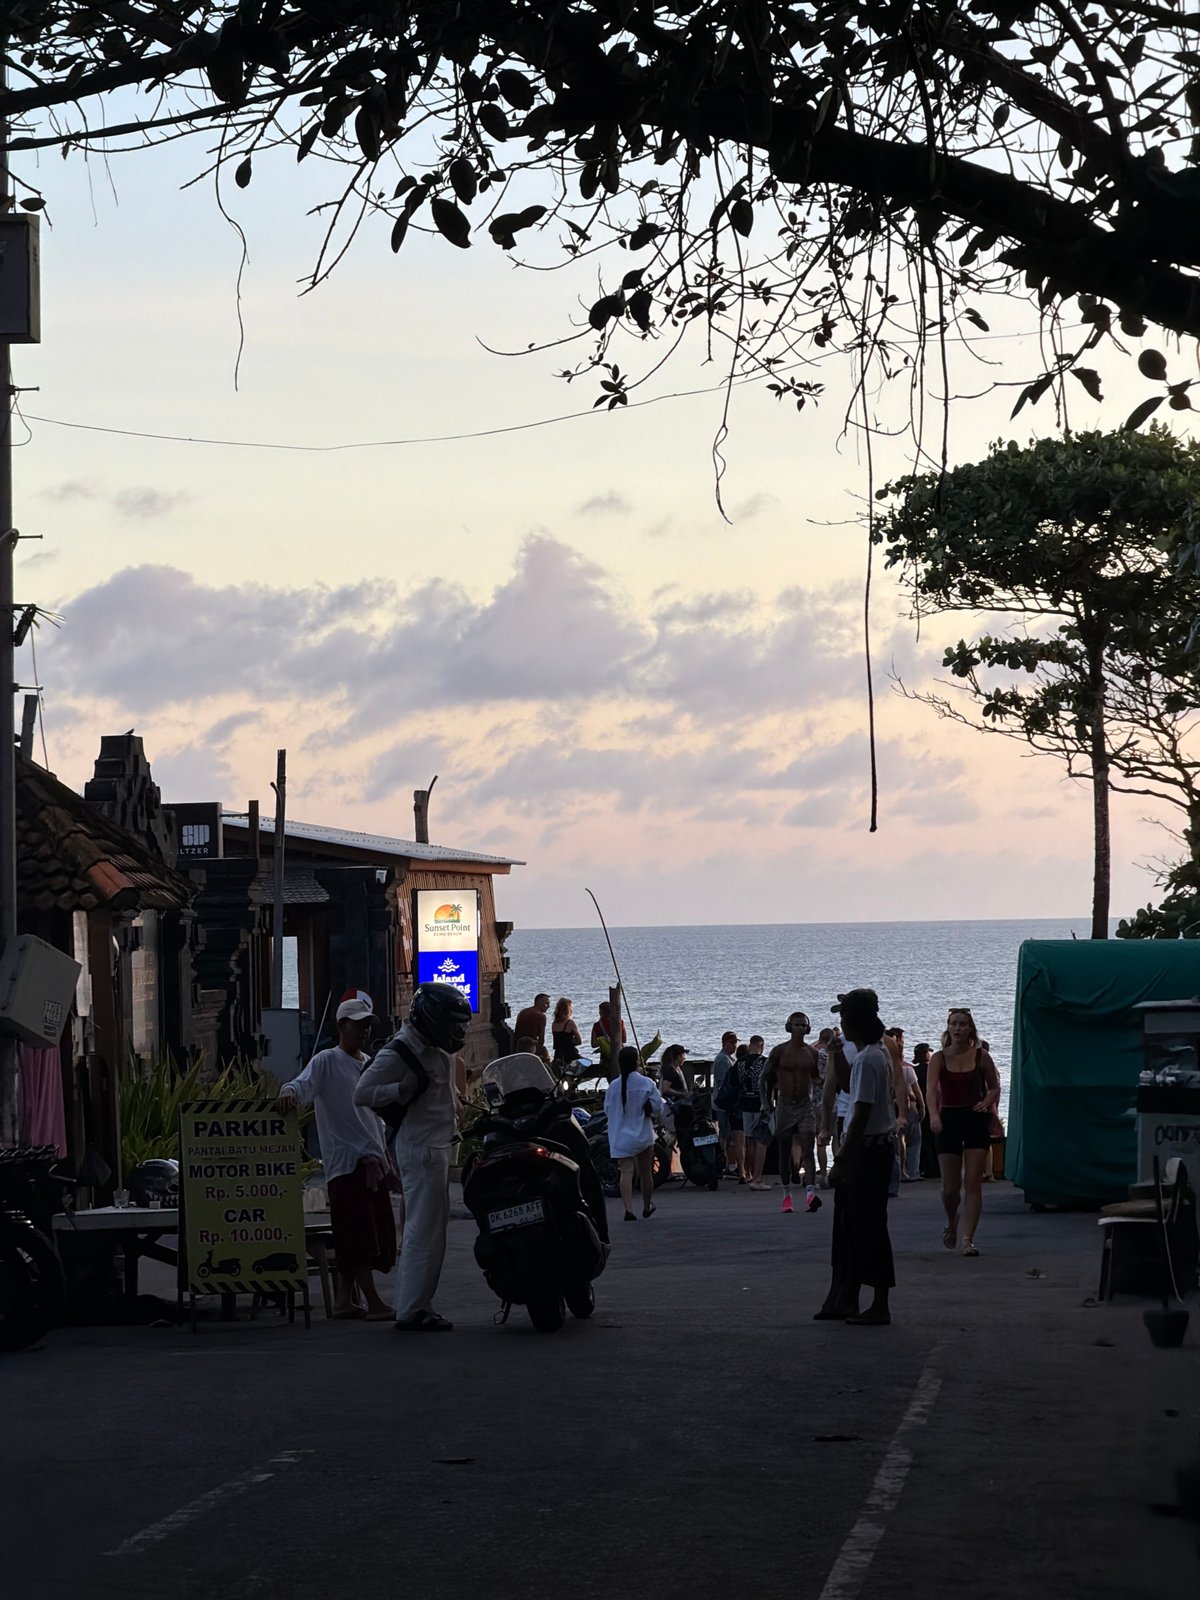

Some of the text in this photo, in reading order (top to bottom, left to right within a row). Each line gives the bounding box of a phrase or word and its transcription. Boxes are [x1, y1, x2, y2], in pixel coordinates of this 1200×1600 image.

[424, 923, 471, 933] Sunset Point
[433, 974, 465, 983] Island
[194, 1119, 286, 1137] PARKIR
[229, 1145, 256, 1155] BATU
[260, 1144, 296, 1154] MEJAN
[189, 1162, 296, 1179] MOTOR BIKE
[205, 1184, 288, 1201] Rp. 5.000,-
[224, 1208, 266, 1223] CAR
[490, 1213, 502, 1223] DK
[526, 1201, 541, 1213] AFF
[200, 1228, 292, 1245] Rp. 10.000,-
